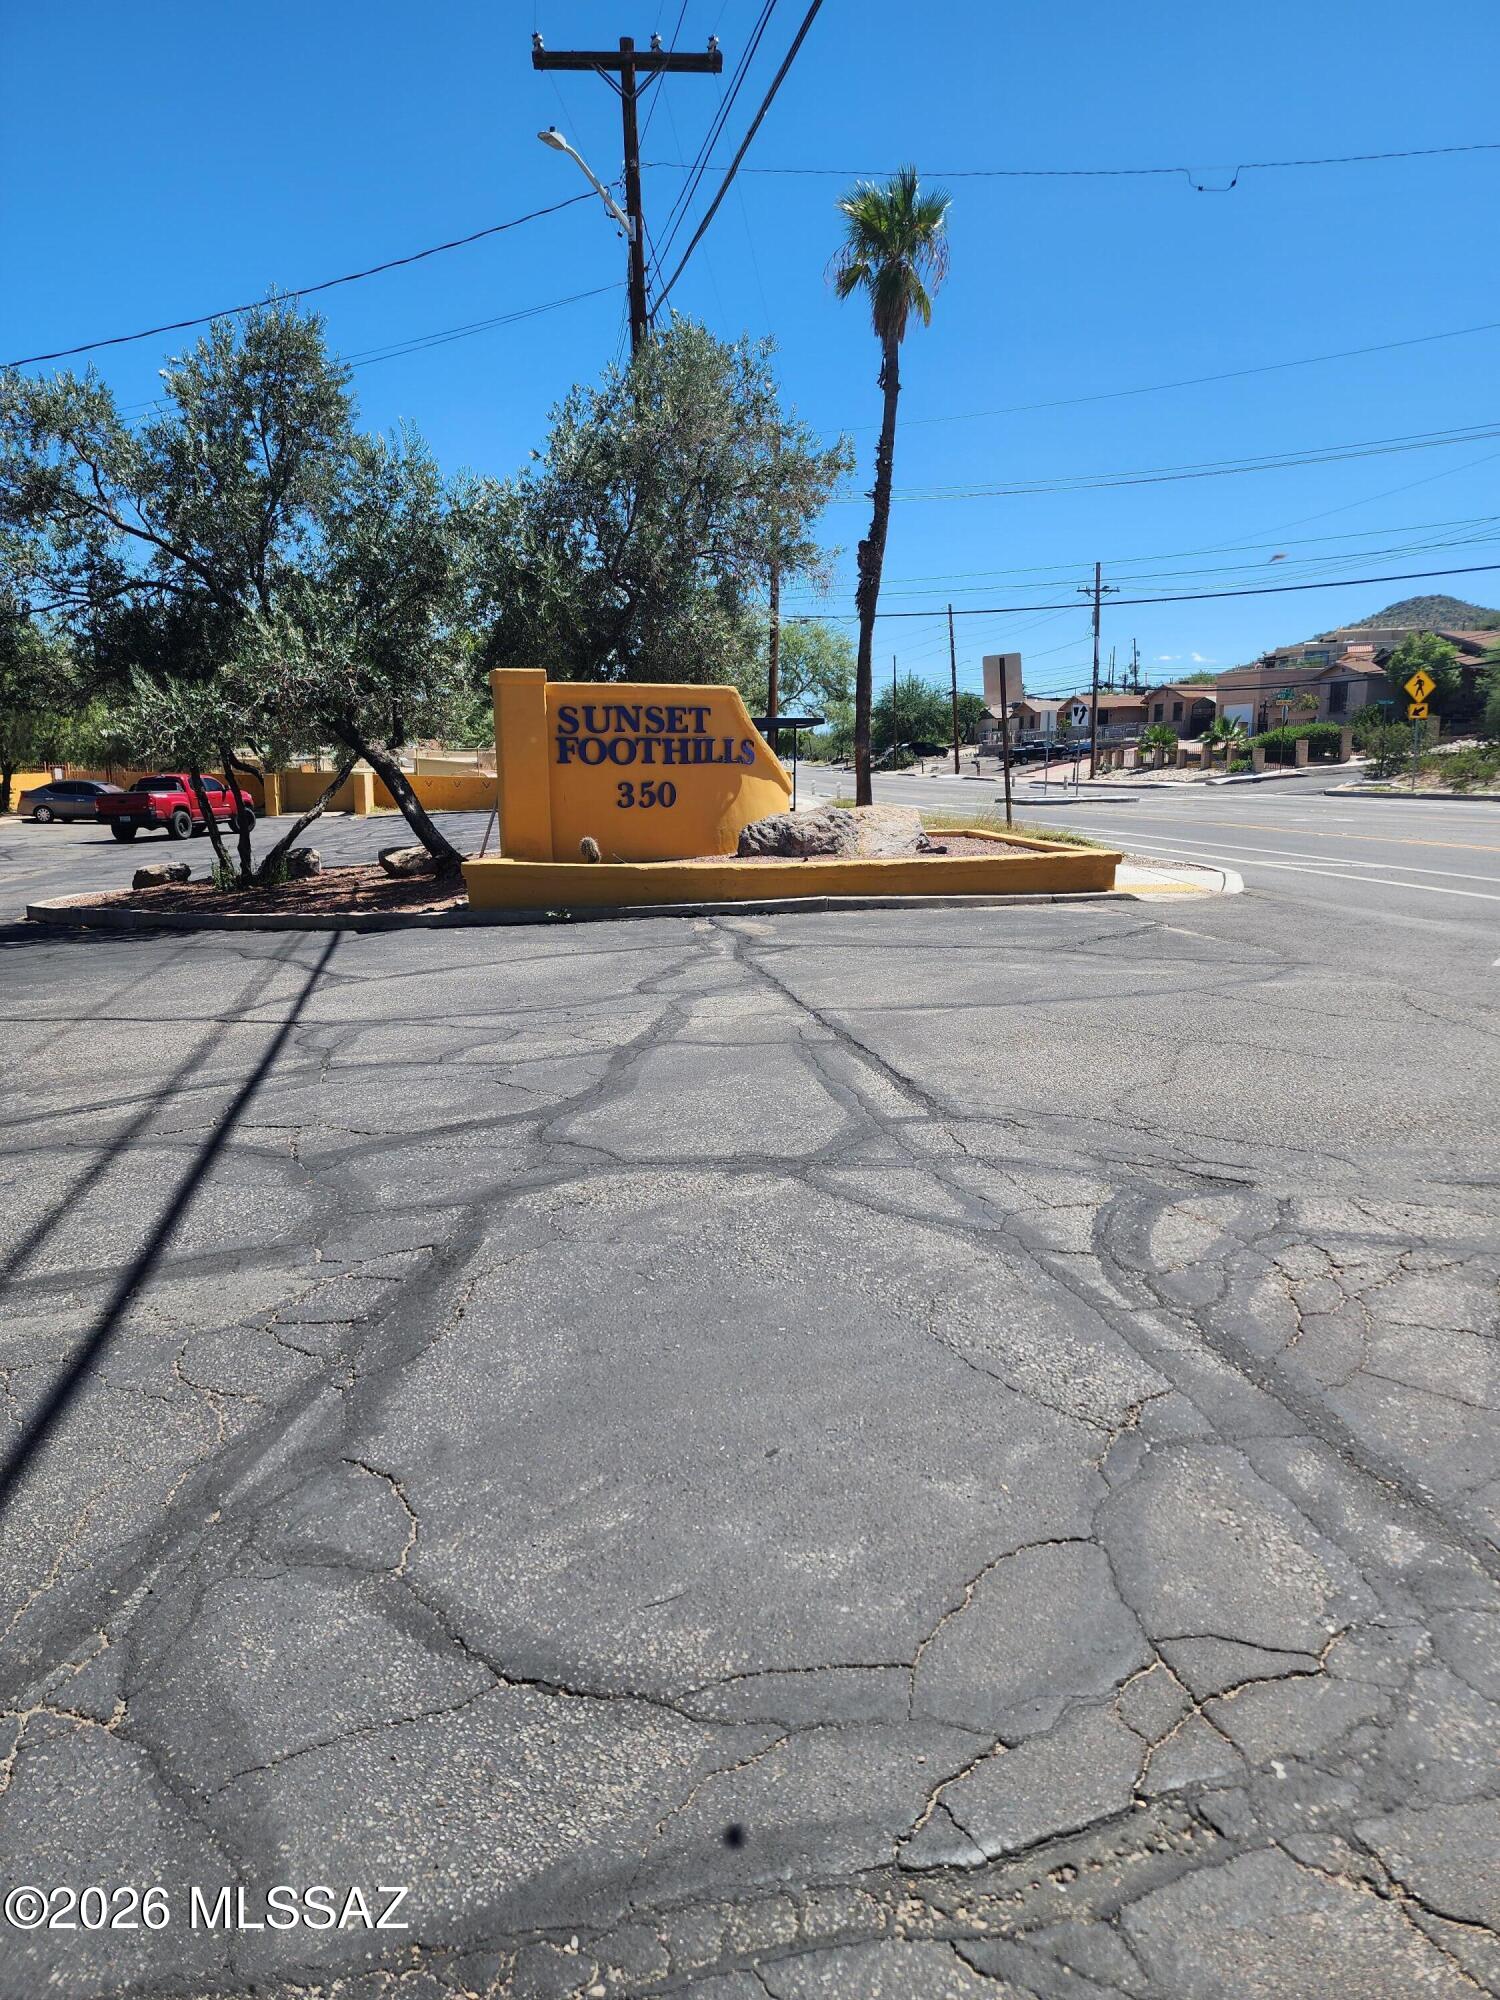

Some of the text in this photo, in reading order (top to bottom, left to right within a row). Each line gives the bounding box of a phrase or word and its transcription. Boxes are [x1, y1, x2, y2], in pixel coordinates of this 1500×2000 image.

[557, 705, 711, 734] SUNSET
[556, 736, 755, 765] FOOTHILLS
[617, 781, 676, 808] 350
